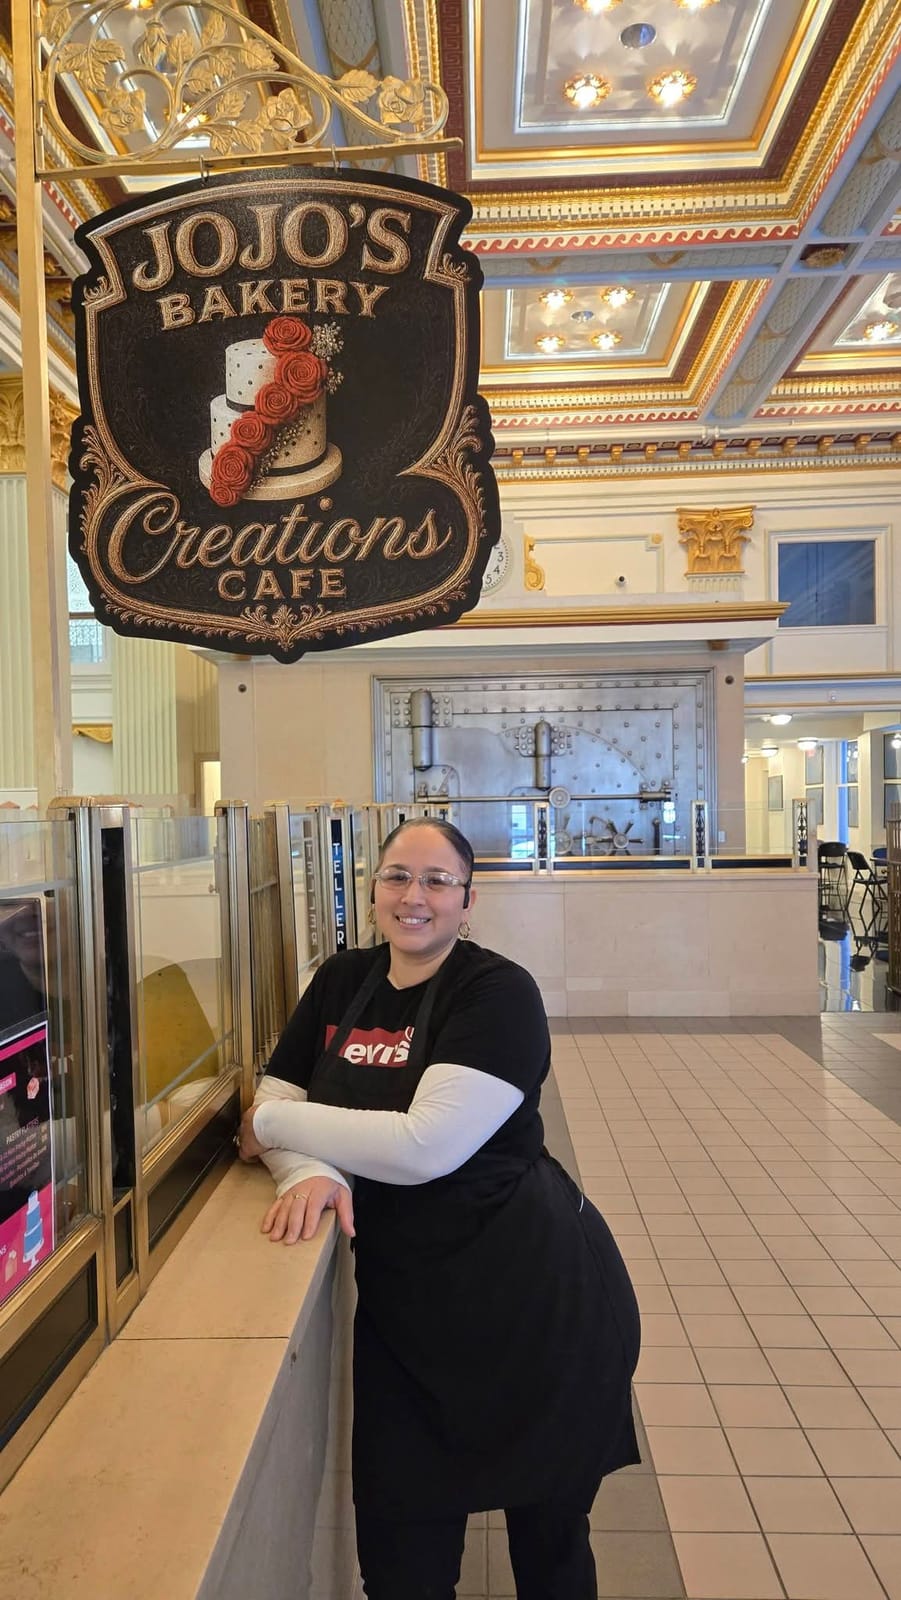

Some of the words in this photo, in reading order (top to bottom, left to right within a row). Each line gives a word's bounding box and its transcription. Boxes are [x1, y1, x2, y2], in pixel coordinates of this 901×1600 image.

[132, 201, 412, 291] JOJO'S
[156, 278, 391, 331] BAKERY
[107, 491, 452, 584] Creations
[497, 551, 504, 562] 3
[217, 568, 348, 600] CAFE
[493, 565, 500, 575] 4
[332, 842, 345, 945] TELLER
[343, 1040, 410, 1065] evi's
